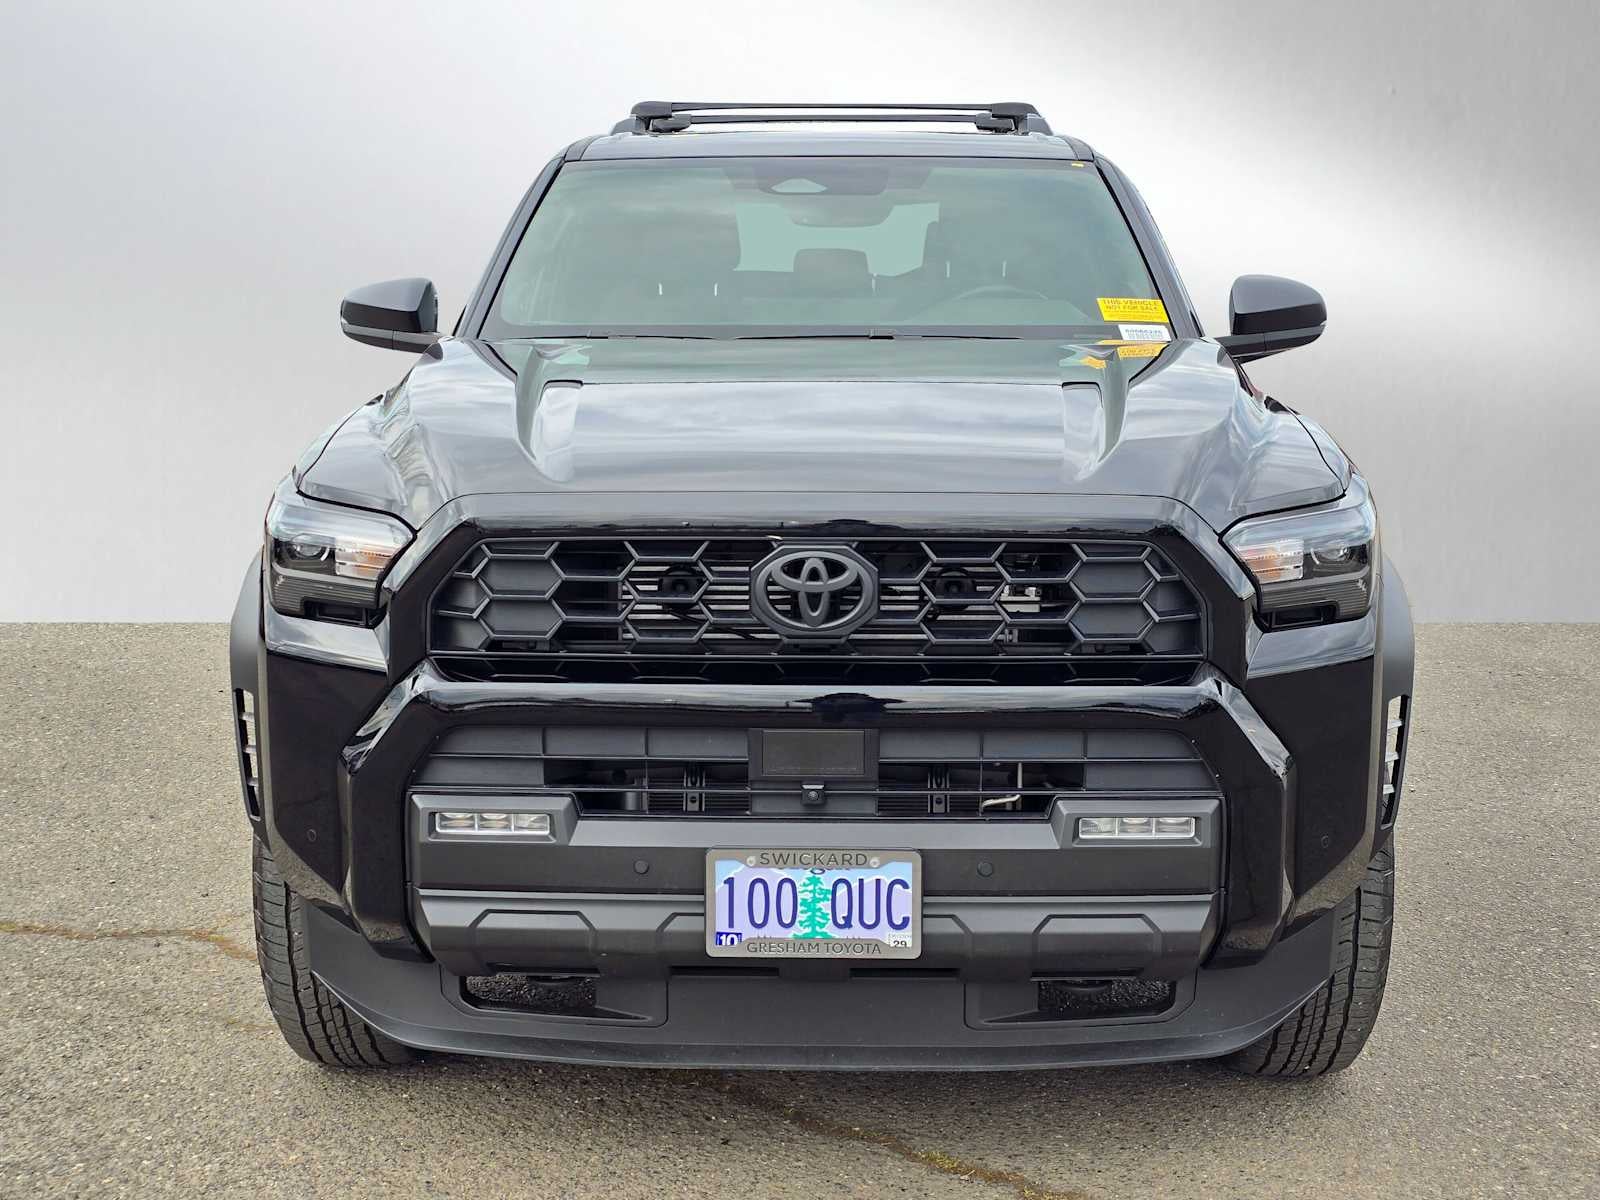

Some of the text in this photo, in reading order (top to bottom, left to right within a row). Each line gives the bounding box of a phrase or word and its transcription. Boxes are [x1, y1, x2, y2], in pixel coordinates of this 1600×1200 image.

[759, 852, 868, 866] SWICKARD
[723, 876, 911, 930] 100 QUC
[719, 933, 739, 946] 10
[746, 942, 882, 955] GRESHAM TOYOTA
